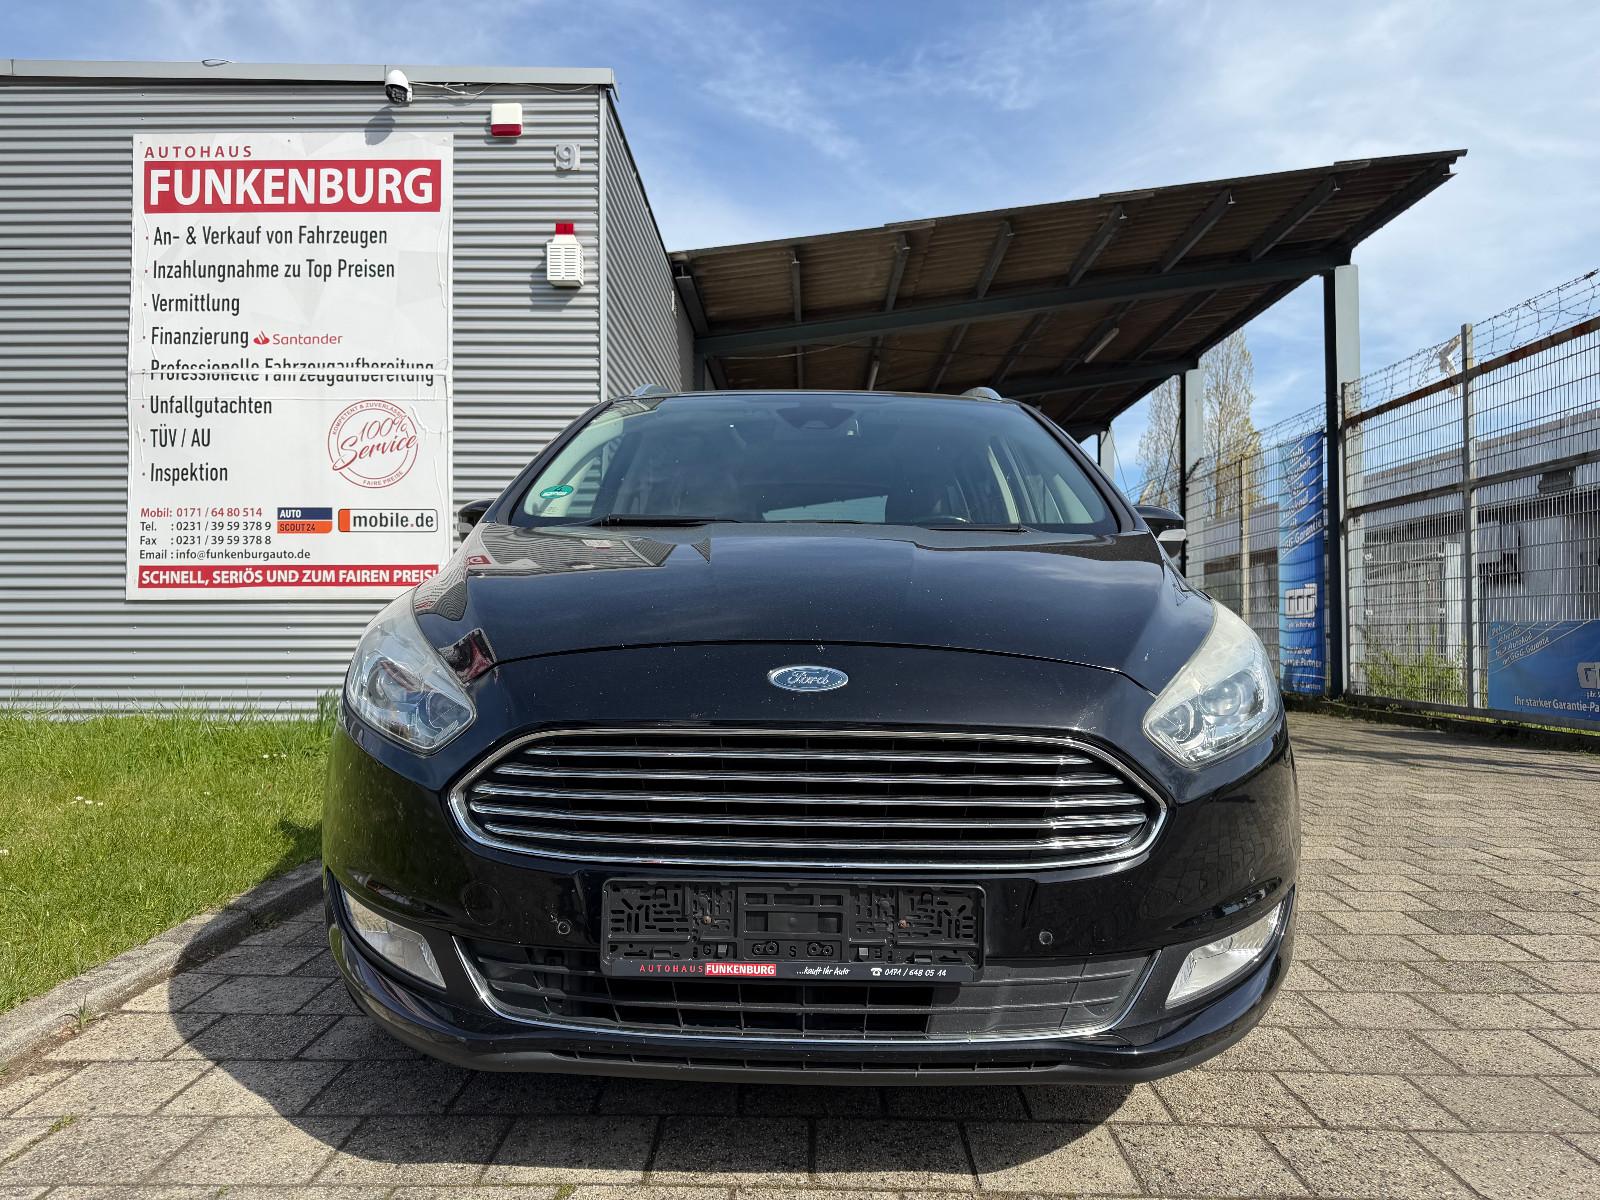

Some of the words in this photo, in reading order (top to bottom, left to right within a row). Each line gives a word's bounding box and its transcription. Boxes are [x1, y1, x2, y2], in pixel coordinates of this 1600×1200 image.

[145, 146, 251, 158] AUTOHAUS
[556, 145, 575, 171] 9
[151, 168, 432, 205] FUNKENBURG
[154, 227, 179, 245] An-
[186, 226, 196, 244] &
[203, 226, 261, 244] Verkauf
[266, 231, 292, 244] von
[299, 226, 387, 248] Fahrzeugen
[154, 260, 278, 282] Inzahlungnahme
[284, 265, 300, 277] zu
[306, 259, 331, 282] Top
[338, 259, 394, 277] Preisen
[152, 293, 239, 316] Vermittlung
[152, 327, 248, 348] Finanzierung
[273, 334, 343, 344] Santander
[151, 358, 259, 381] Professionelle
[266, 358, 433, 386] Fahrzeugaufbereitung
[151, 396, 271, 418] Unfallgutachten
[150, 424, 176, 447] TÜV
[181, 429, 186, 447] /
[191, 429, 210, 447] AU
[360, 415, 408, 442] 100%
[333, 434, 417, 471] Service
[151, 463, 227, 486] Inspektion
[141, 508, 172, 517] Mobil:
[177, 508, 200, 517] 0171
[205, 507, 209, 517] /
[211, 508, 224, 517] 64
[227, 508, 240, 517] 80
[243, 508, 262, 517] 514
[280, 510, 301, 518] AUTO
[353, 513, 433, 527] mobile.de
[140, 521, 156, 531] Tel.
[176, 522, 200, 530] 0231
[205, 521, 208, 531] /
[211, 522, 224, 530] 39
[227, 522, 239, 530] 59
[243, 522, 262, 530] 378
[265, 522, 271, 530] 9
[140, 536, 156, 545] Fax
[176, 536, 200, 544] 0231
[205, 536, 208, 545] /
[211, 536, 224, 544] 39
[227, 536, 239, 544] 59
[243, 536, 262, 544] 378
[265, 536, 271, 544] 8
[140, 550, 167, 559] Email
[176, 549, 310, 561] info@funkenburgauto.de
[142, 571, 209, 585] SCHNELL,
[213, 568, 263, 584] SERIÖS
[267, 570, 299, 582] UND
[302, 570, 335, 582] ZUM
[339, 570, 389, 582] FAIREN
[787, 670, 830, 685] Ford
[1514, 695, 1524, 705] Ihr
[1525, 697, 1552, 708] starker
[706, 965, 774, 976] FUNKENBURG
[821, 966, 833, 974] Ihr
[903, 968, 908, 976] /
